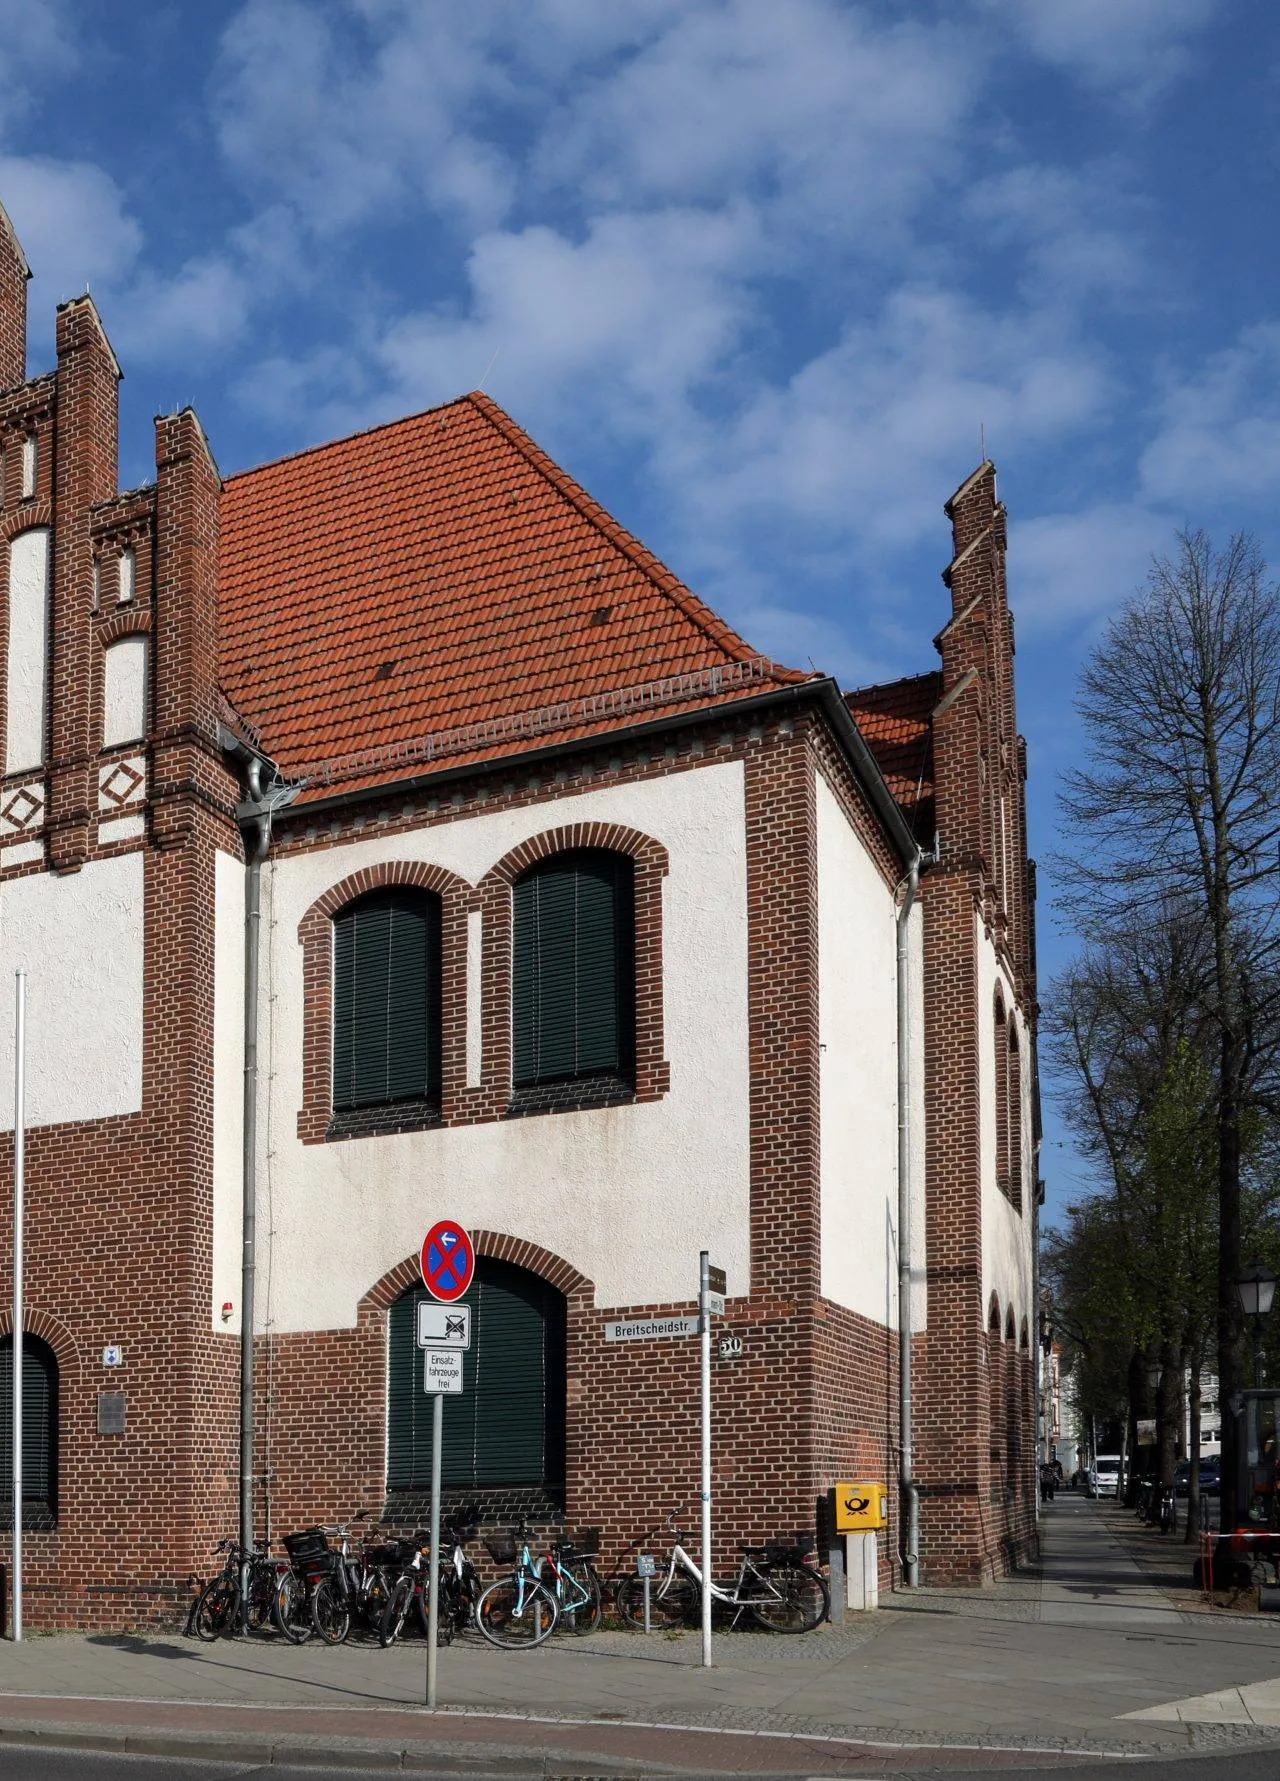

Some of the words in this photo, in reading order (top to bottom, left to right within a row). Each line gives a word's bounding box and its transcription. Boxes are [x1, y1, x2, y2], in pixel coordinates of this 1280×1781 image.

[615, 1321, 691, 1337] Breitscheidstr.
[720, 1337, 741, 1352] 50
[431, 1355, 456, 1365] Einsatz-
[429, 1367, 459, 1378] fahrzeuge
[438, 1379, 450, 1388] frei
